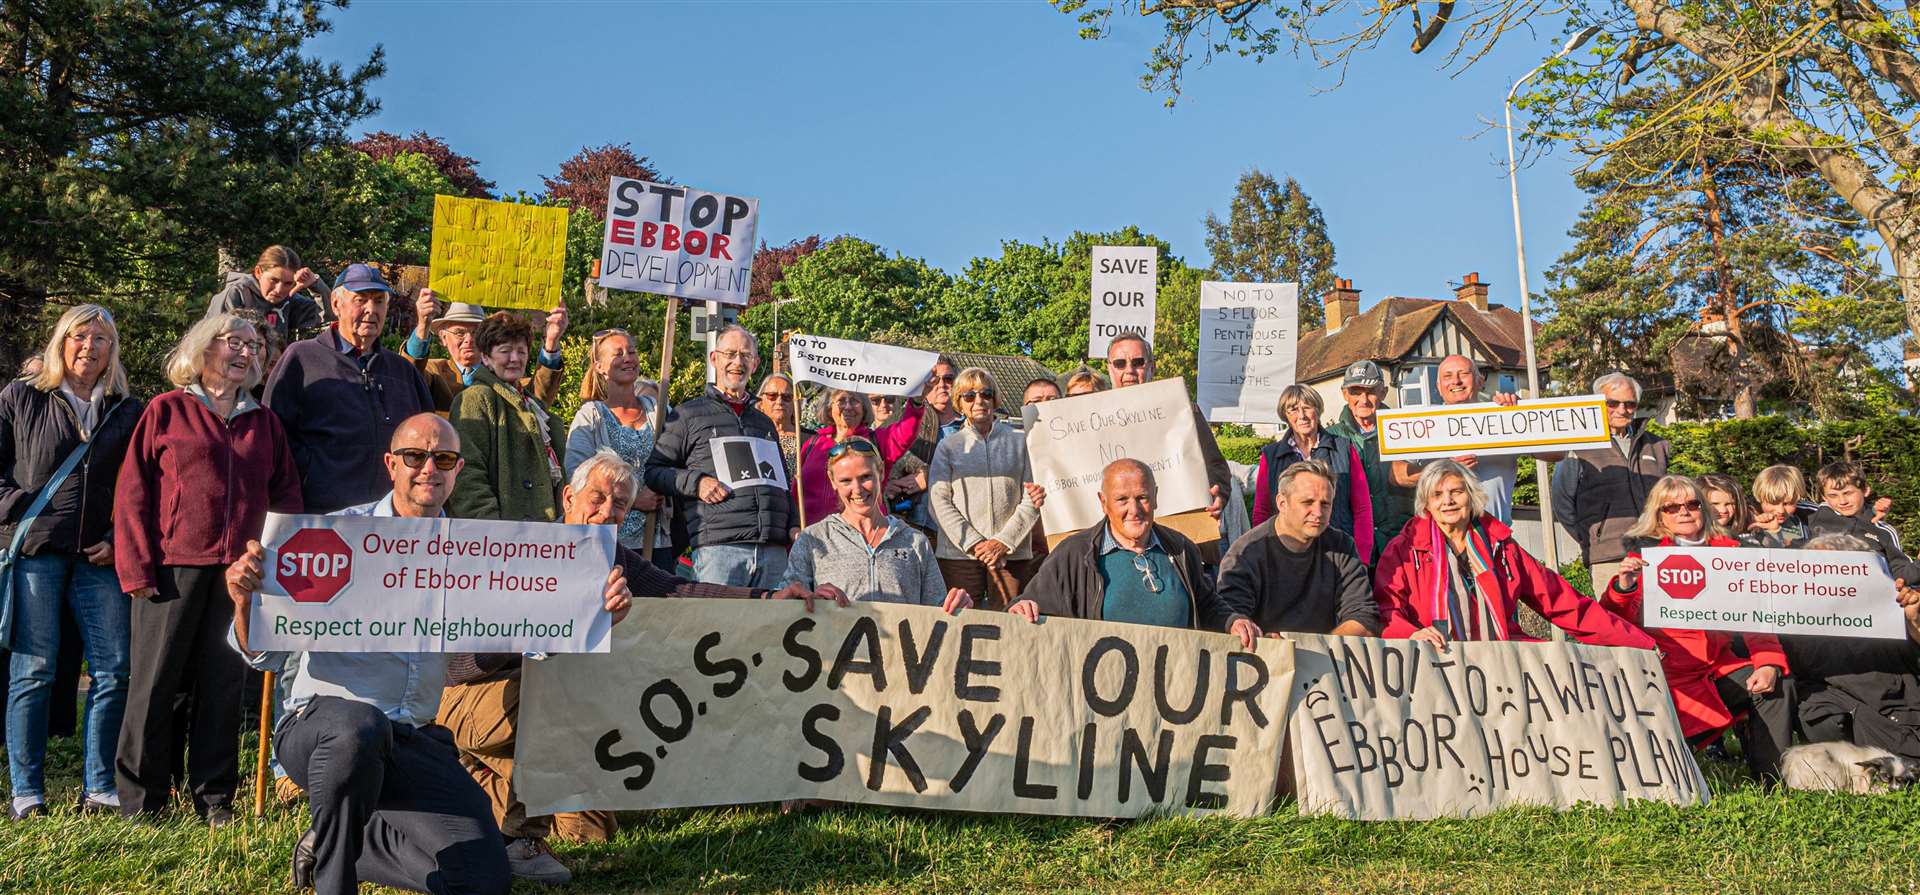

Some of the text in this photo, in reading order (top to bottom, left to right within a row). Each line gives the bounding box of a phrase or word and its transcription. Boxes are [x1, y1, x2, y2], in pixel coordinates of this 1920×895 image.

[613, 180, 749, 235] STOP
[610, 218, 733, 261] EBBOR
[606, 249, 750, 292] DEVELOPMENT
[1099, 258, 1149, 275] SAVE
[1102, 291, 1145, 307] OUR
[1224, 289, 1274, 301] NO TO
[1219, 306, 1281, 320] 5 FLOOR
[1095, 323, 1147, 339] TOWN
[1214, 328, 1288, 340] PENTHOUSE
[790, 337, 827, 350] NO TO
[1231, 344, 1273, 356] FLATS
[797, 350, 856, 367] 5-STOREY
[809, 366, 907, 386] DEVELOPMENTS
[1230, 375, 1271, 386] HYTHE
[1117, 408, 1166, 427] SKYLINE
[1389, 407, 1600, 440] STOP DEVELOPMENT
[1099, 440, 1126, 465] NO
[362, 533, 577, 563] Over development
[280, 552, 349, 577] STOP
[1711, 557, 1869, 577] Over development
[383, 567, 558, 592] of Ebbor House
[1659, 569, 1704, 585] STOP
[1728, 579, 1857, 597] of Ebbor House
[1660, 606, 1873, 628] Respect our Neighbourhood
[275, 615, 574, 641] Respect our Neighbourhood
[782, 616, 1001, 702] SAVE
[1082, 636, 1270, 729] OUR
[1432, 660, 1488, 717] TO
[1523, 660, 1655, 723] AWFUL
[798, 703, 1238, 809] SKYLINE
[1313, 713, 1465, 788] EBBOR
